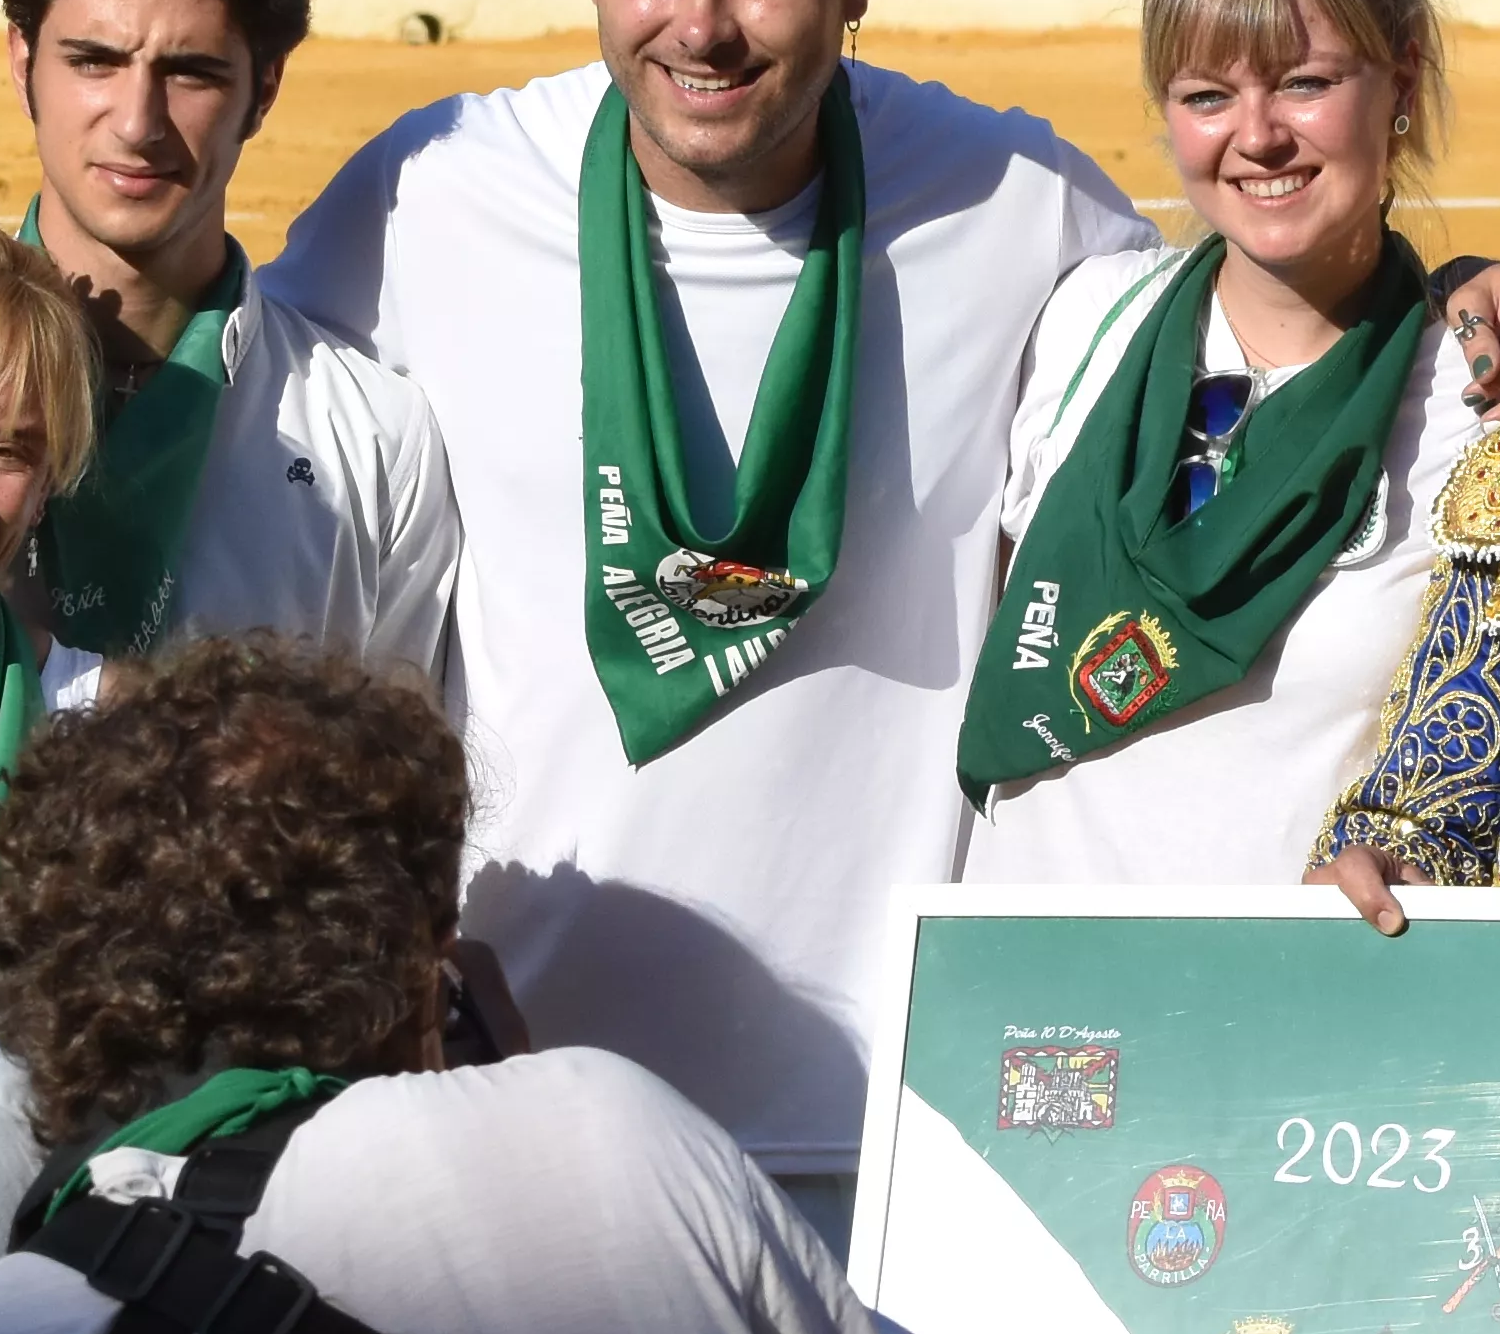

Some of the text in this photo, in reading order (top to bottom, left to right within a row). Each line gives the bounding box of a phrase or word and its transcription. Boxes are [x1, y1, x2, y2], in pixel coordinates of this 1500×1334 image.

[598, 465, 633, 545] PEÑA
[602, 565, 696, 676] ALEGRIA
[1012, 580, 1060, 670] PEÑA
[1040, 1026, 1056, 1039] 10
[1274, 1117, 1456, 1193] 2023
[1134, 1253, 1209, 1284] PARRILLA
[1166, 1227, 1186, 1240] LA
